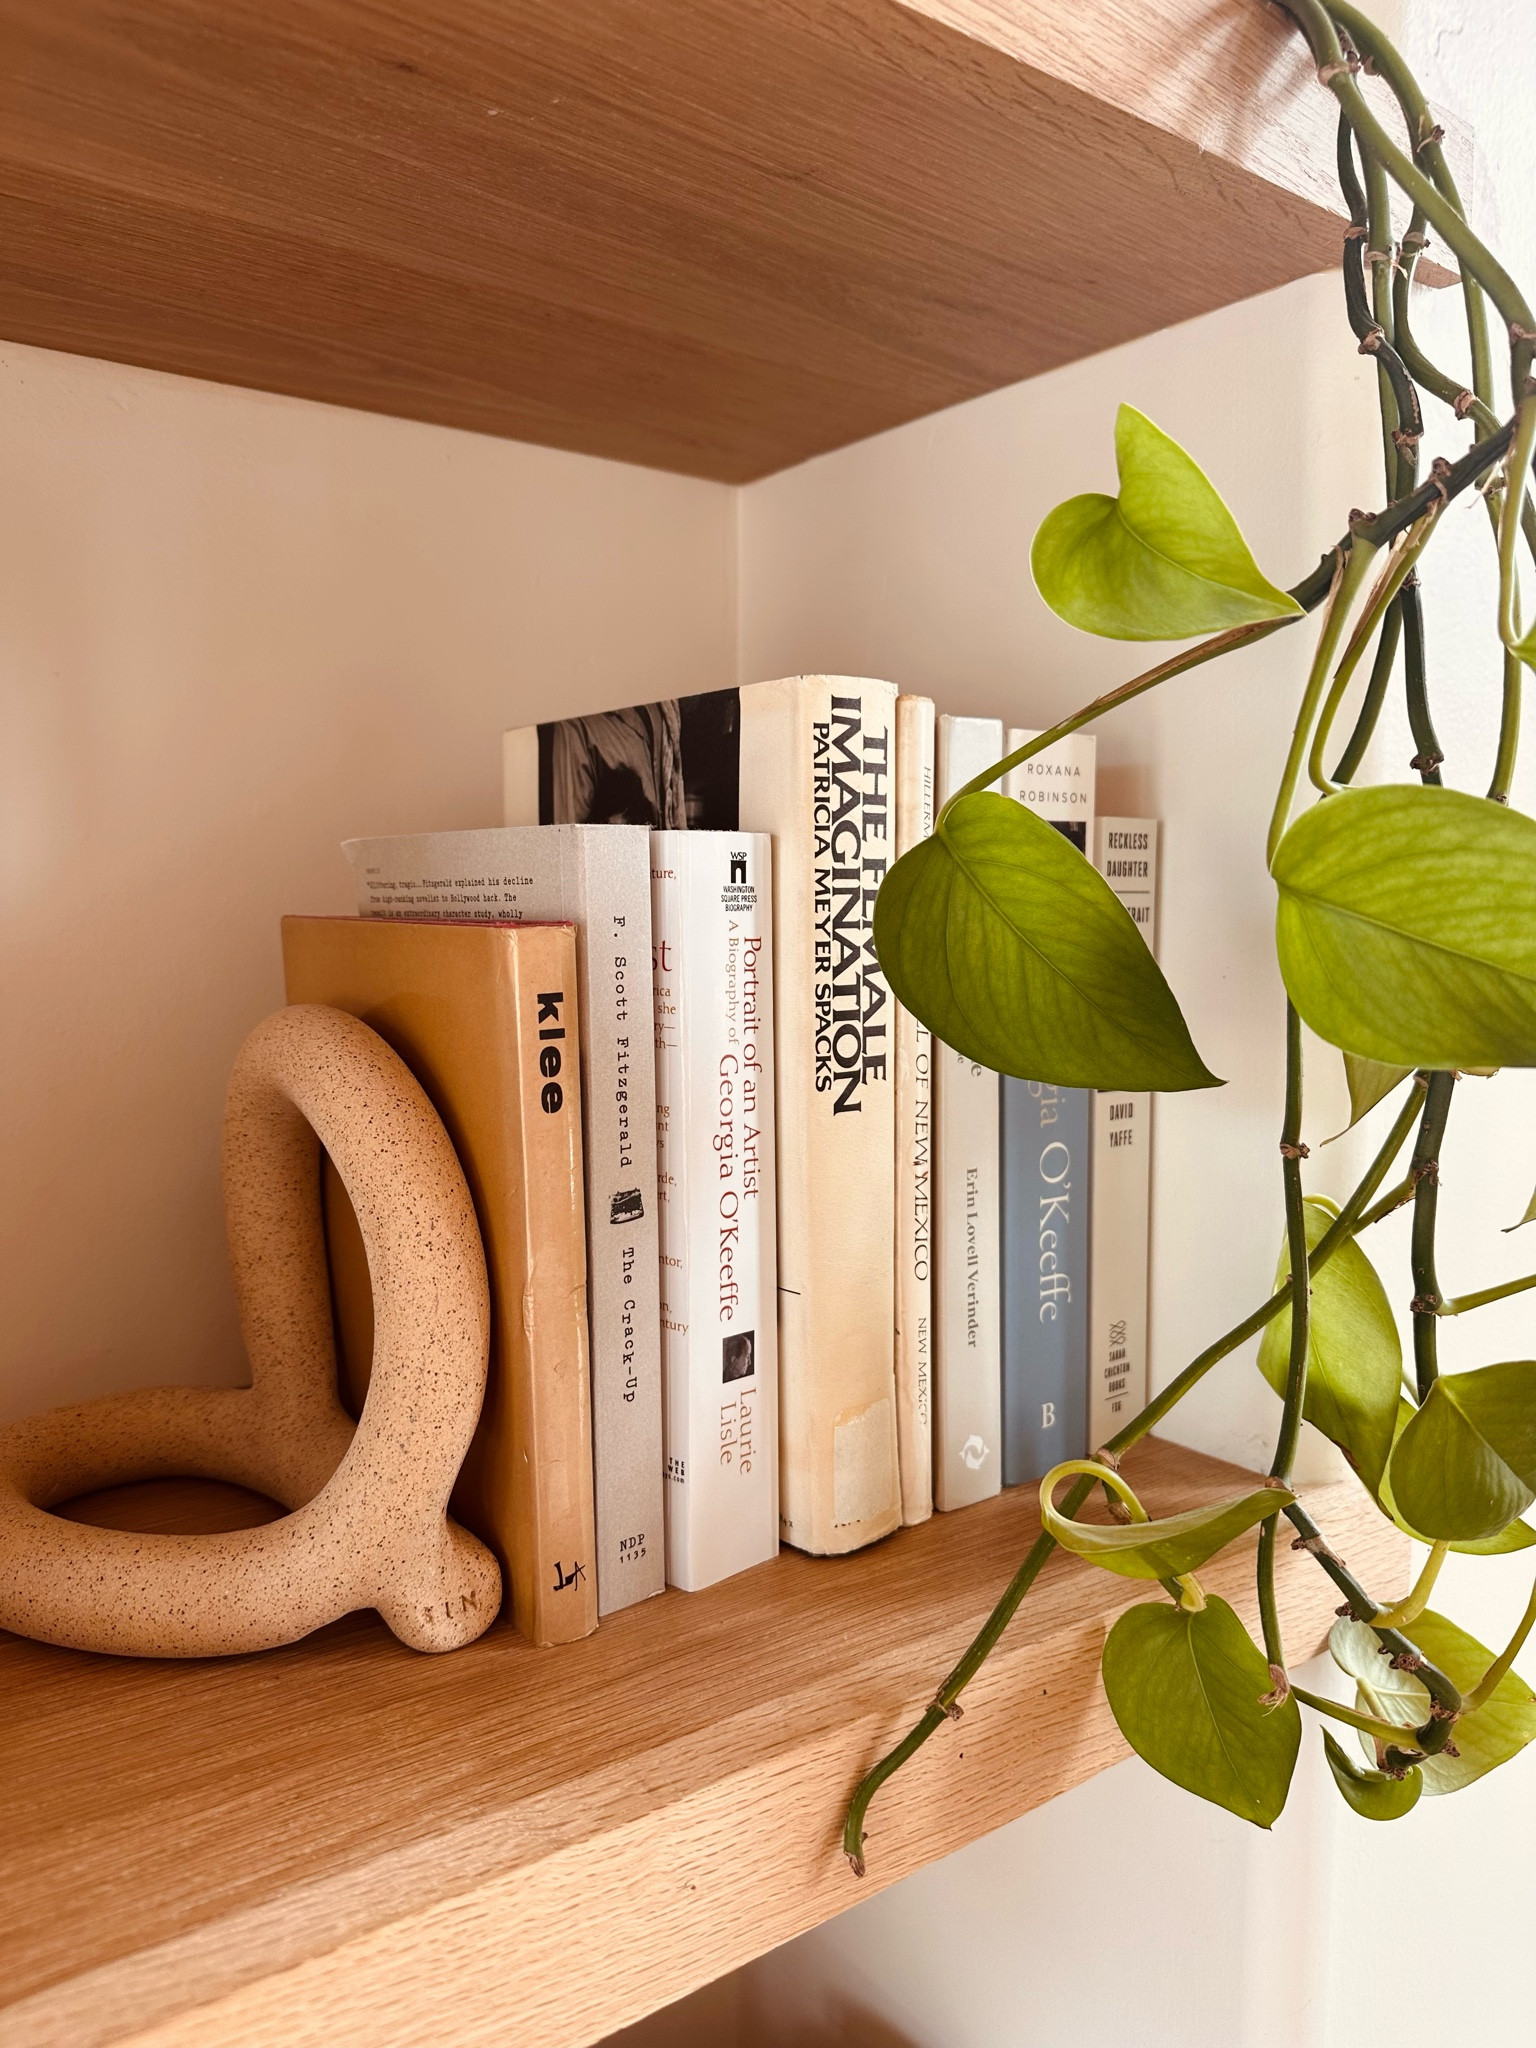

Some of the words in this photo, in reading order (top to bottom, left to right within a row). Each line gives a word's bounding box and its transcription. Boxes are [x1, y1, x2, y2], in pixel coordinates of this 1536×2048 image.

[862, 725, 888, 843] THE
[1027, 763, 1081, 778] ROXANA
[813, 722, 830, 859] PATRICIA
[922, 765, 932, 840] HILLERM
[1019, 790, 1088, 805] ROBINSON
[730, 851, 747, 860] WSP
[1108, 832, 1148, 850] RECKLESS
[455, 878, 485, 889] explained
[488, 877, 500, 886] his
[503, 876, 534, 886] decline
[1106, 860, 1148, 878] DAUGHTER
[416, 894, 440, 903] novelist
[442, 894, 448, 903] to
[451, 893, 480, 904] Hollywood
[483, 893, 501, 902] hack.
[504, 893, 517, 902] The
[721, 894, 740, 903] SQUARE
[741, 894, 758, 903] PRESS
[723, 885, 755, 893] WASHINGTON
[831, 694, 862, 1117] IMAGINATION
[443, 909, 472, 919] character
[474, 909, 495, 920] study,
[498, 908, 523, 920] wholly
[725, 903, 753, 912] BIOGRAPHY
[814, 868, 831, 975] MEYER
[613, 916, 626, 938] F.
[728, 920, 739, 932] A
[614, 956, 628, 1021] Scott
[725, 937, 740, 1022] Biography
[743, 936, 762, 1035] Portrait
[861, 857, 887, 1086] FEMALE
[657, 1002, 676, 1015] she
[537, 991, 566, 1114] klee
[728, 1028, 740, 1045] of
[815, 983, 832, 1093] SPACKS
[743, 1043, 763, 1073] of
[915, 1053, 928, 1090] OF
[616, 1037, 632, 1168] Fitzgerald
[743, 1079, 758, 1114] an
[1109, 1102, 1134, 1121] DAVID
[713, 1054, 739, 1180] Georgia
[914, 1100, 928, 1163] NEW
[1109, 1129, 1133, 1148] YAFFE
[743, 1122, 761, 1201] Artist
[966, 1167, 978, 1208] Erin
[914, 1173, 928, 1281] MEXICO
[966, 1212, 979, 1267] Lovell
[1039, 1141, 1071, 1325] O'Keeffe
[622, 1248, 635, 1284] The
[719, 1191, 739, 1323] O'Keeffe
[967, 1269, 980, 1348] Verinder
[621, 1299, 637, 1403] Crack-Up
[918, 1317, 928, 1354] NEW
[1104, 1361, 1131, 1379] CRICHTON
[1109, 1348, 1126, 1362] SARAH
[1108, 1377, 1126, 1393] BOOKS
[720, 1401, 738, 1465] Lisle
[740, 1387, 757, 1476] Laurie
[1041, 1401, 1056, 1429] B
[667, 1464, 685, 1476] WEB
[619, 1532, 646, 1552] NDP
[619, 1547, 647, 1564] 1135
